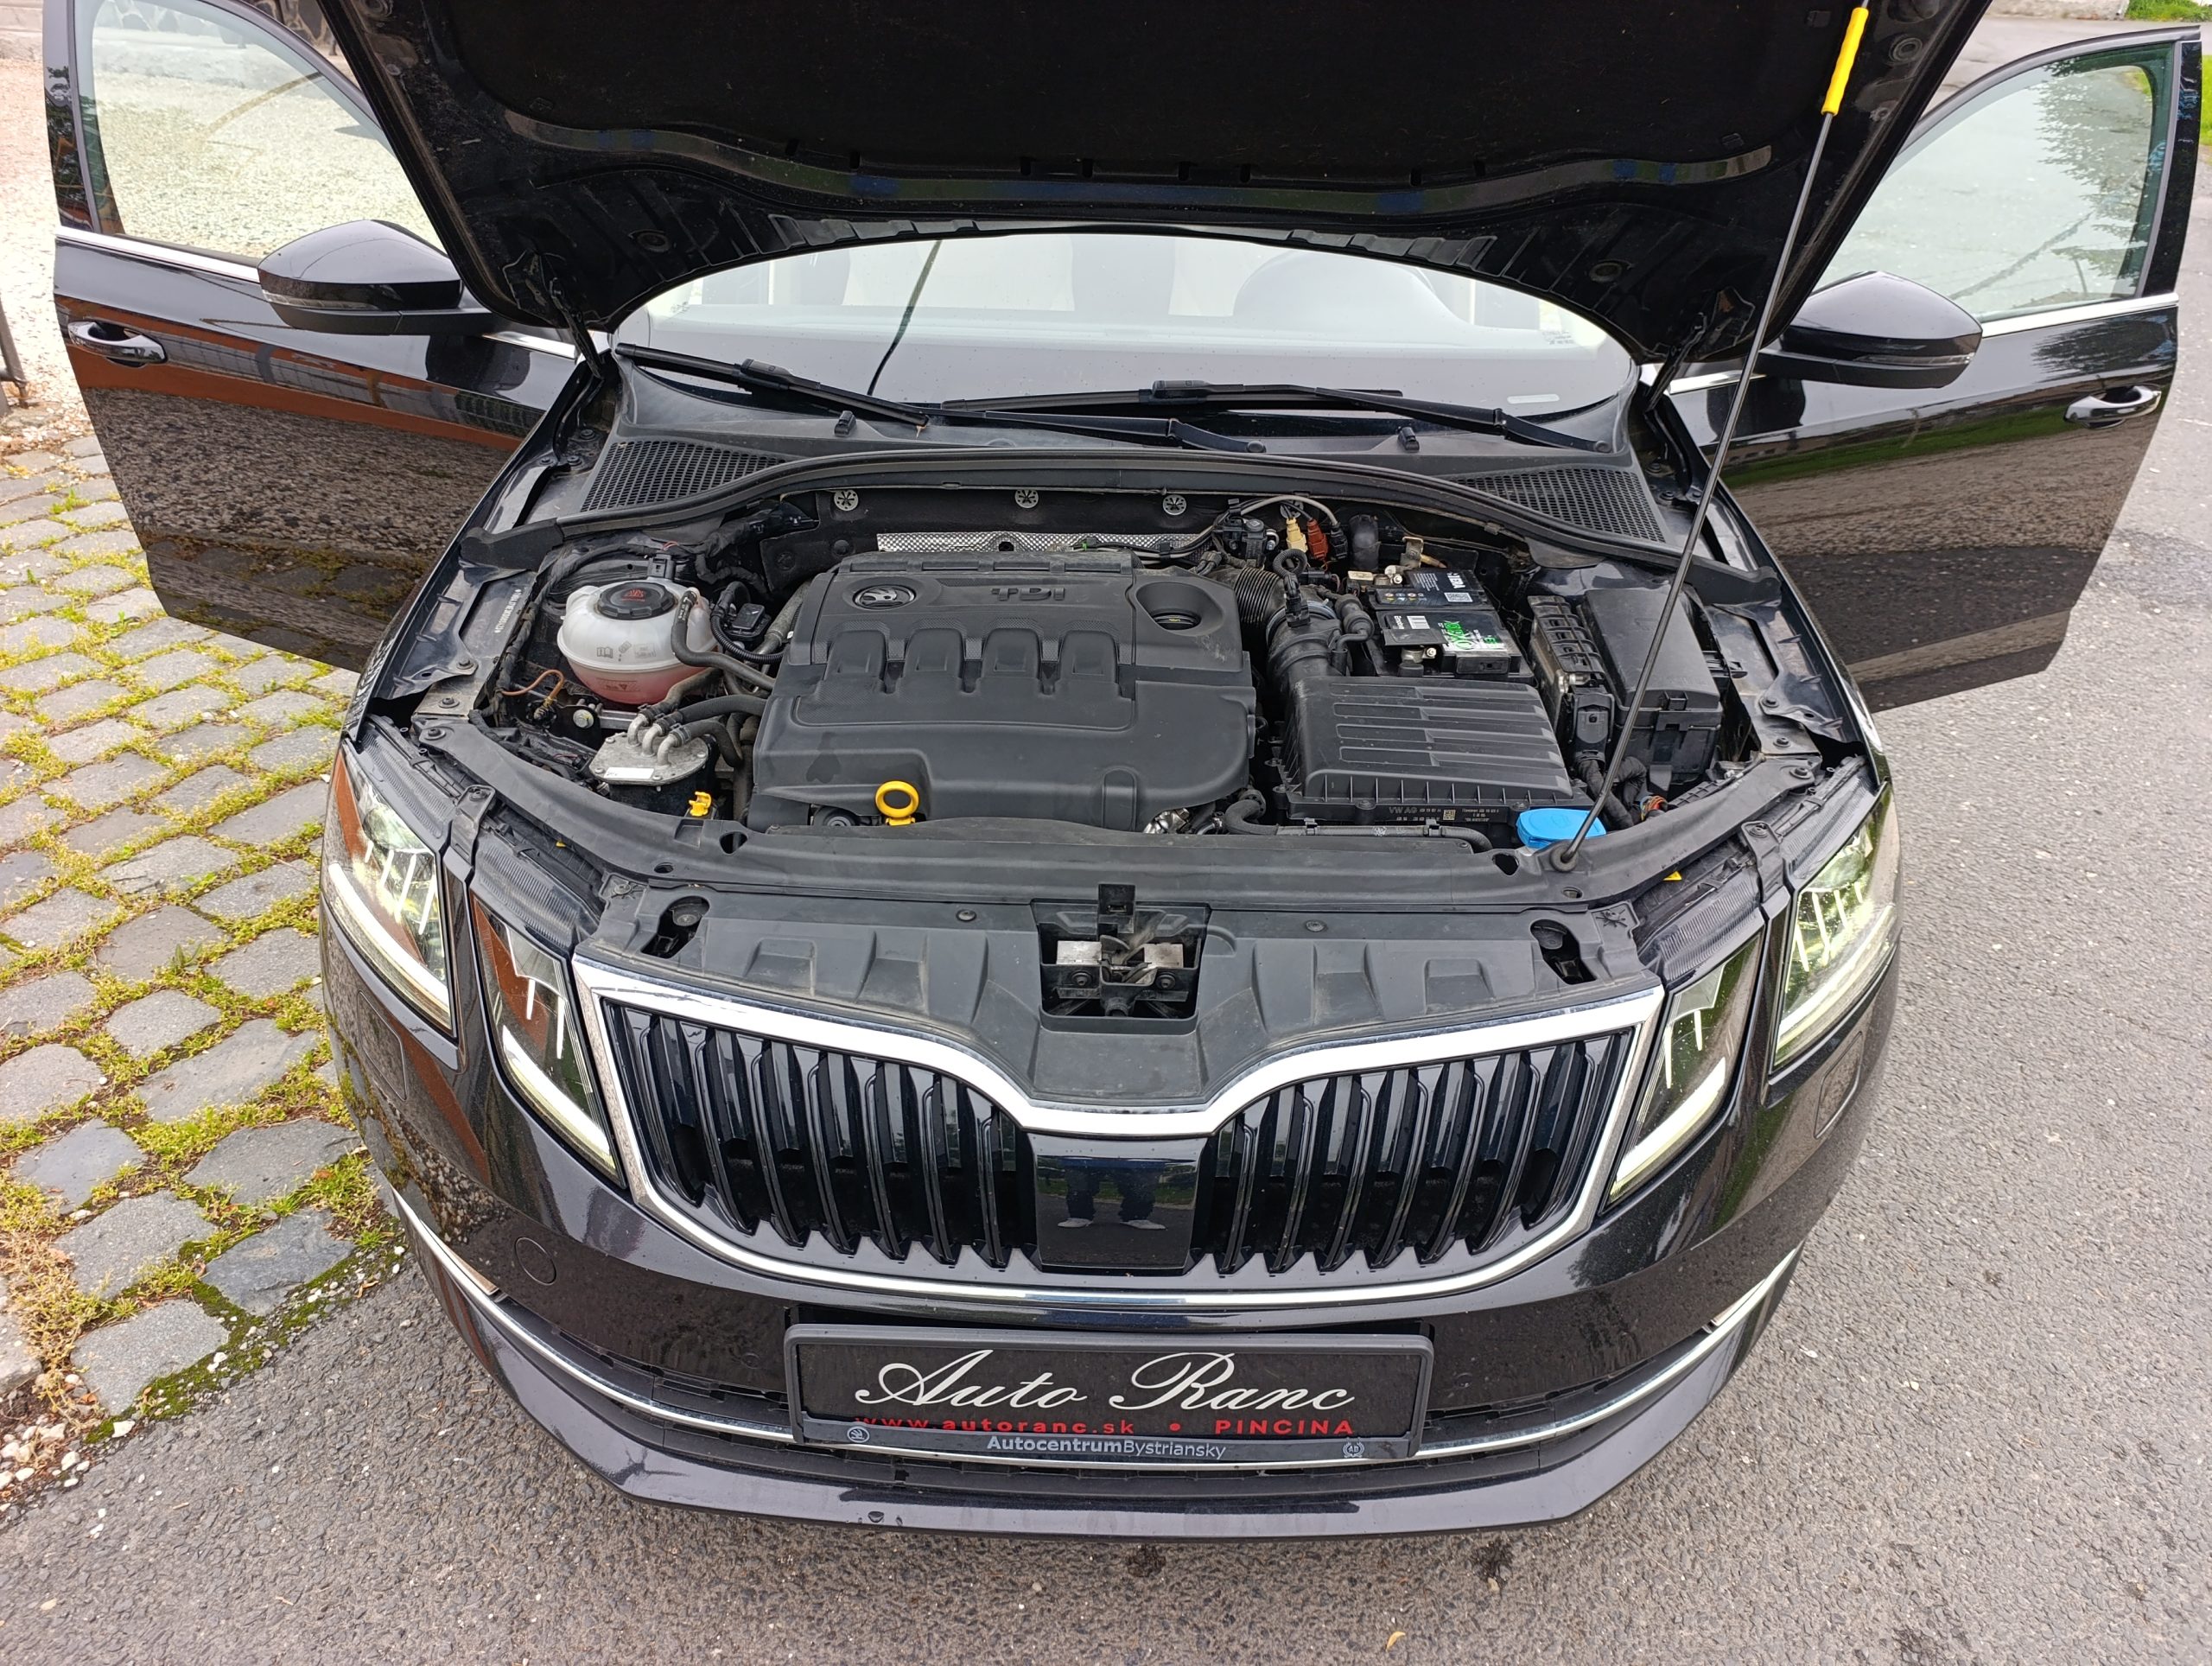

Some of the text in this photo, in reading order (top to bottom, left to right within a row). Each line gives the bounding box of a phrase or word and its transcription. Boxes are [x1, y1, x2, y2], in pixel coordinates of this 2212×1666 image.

[991, 588, 1065, 601] TDI
[855, 1349, 1356, 1410] Auto Ranc
[1214, 1420, 1353, 1434] PINCINA
